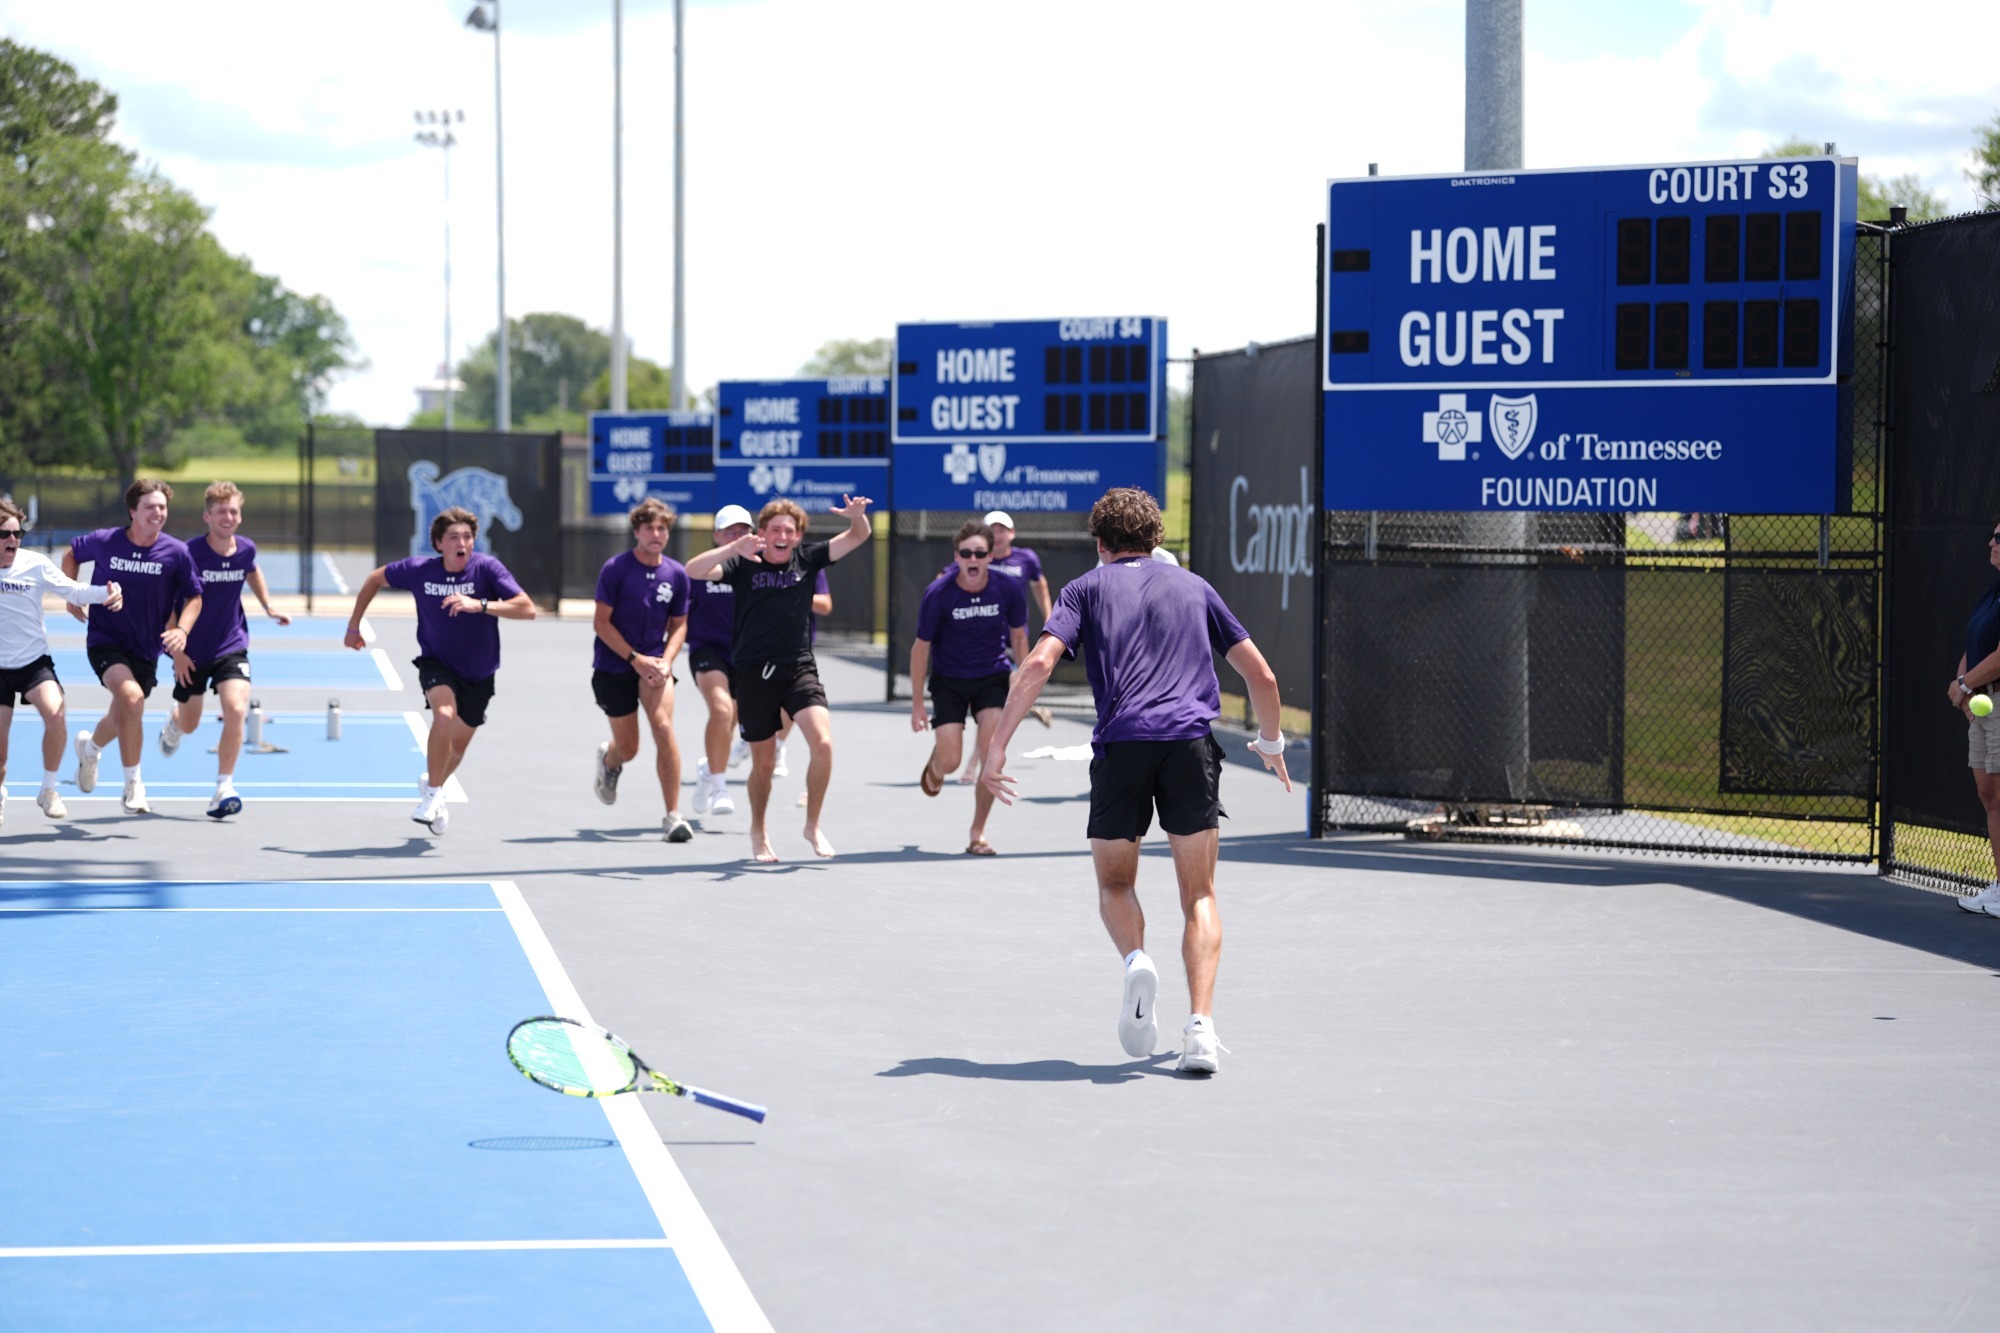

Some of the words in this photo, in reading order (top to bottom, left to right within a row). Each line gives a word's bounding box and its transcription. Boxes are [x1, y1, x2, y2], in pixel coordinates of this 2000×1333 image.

[1451, 176, 1516, 188] DAKTRONICS
[1649, 165, 1759, 204] COURT
[1768, 164, 1809, 200] S3
[1410, 225, 1557, 284] HOME
[1059, 318, 1116, 341] COURT
[1119, 317, 1143, 339] S4
[1399, 308, 1565, 367] GUEST
[936, 347, 1016, 384] HOME
[744, 397, 800, 424] HOME
[931, 395, 1020, 431] GUEST
[609, 427, 652, 449] HOME
[740, 430, 802, 457] GUEST
[1540, 433, 1571, 461] of
[1576, 433, 1722, 461] Tennessee
[607, 451, 653, 474] GUEST
[1004, 466, 1022, 483] of
[1023, 466, 1100, 485] Tennessee
[974, 490, 1067, 511] FOUNDATION
[1481, 477, 1658, 507] FOUNDATION
[110, 556, 163, 575] SEWANEE
[202, 569, 245, 583] SEWANEE
[424, 582, 475, 596] SEWANEE
[952, 603, 1000, 620] SEWANEE
